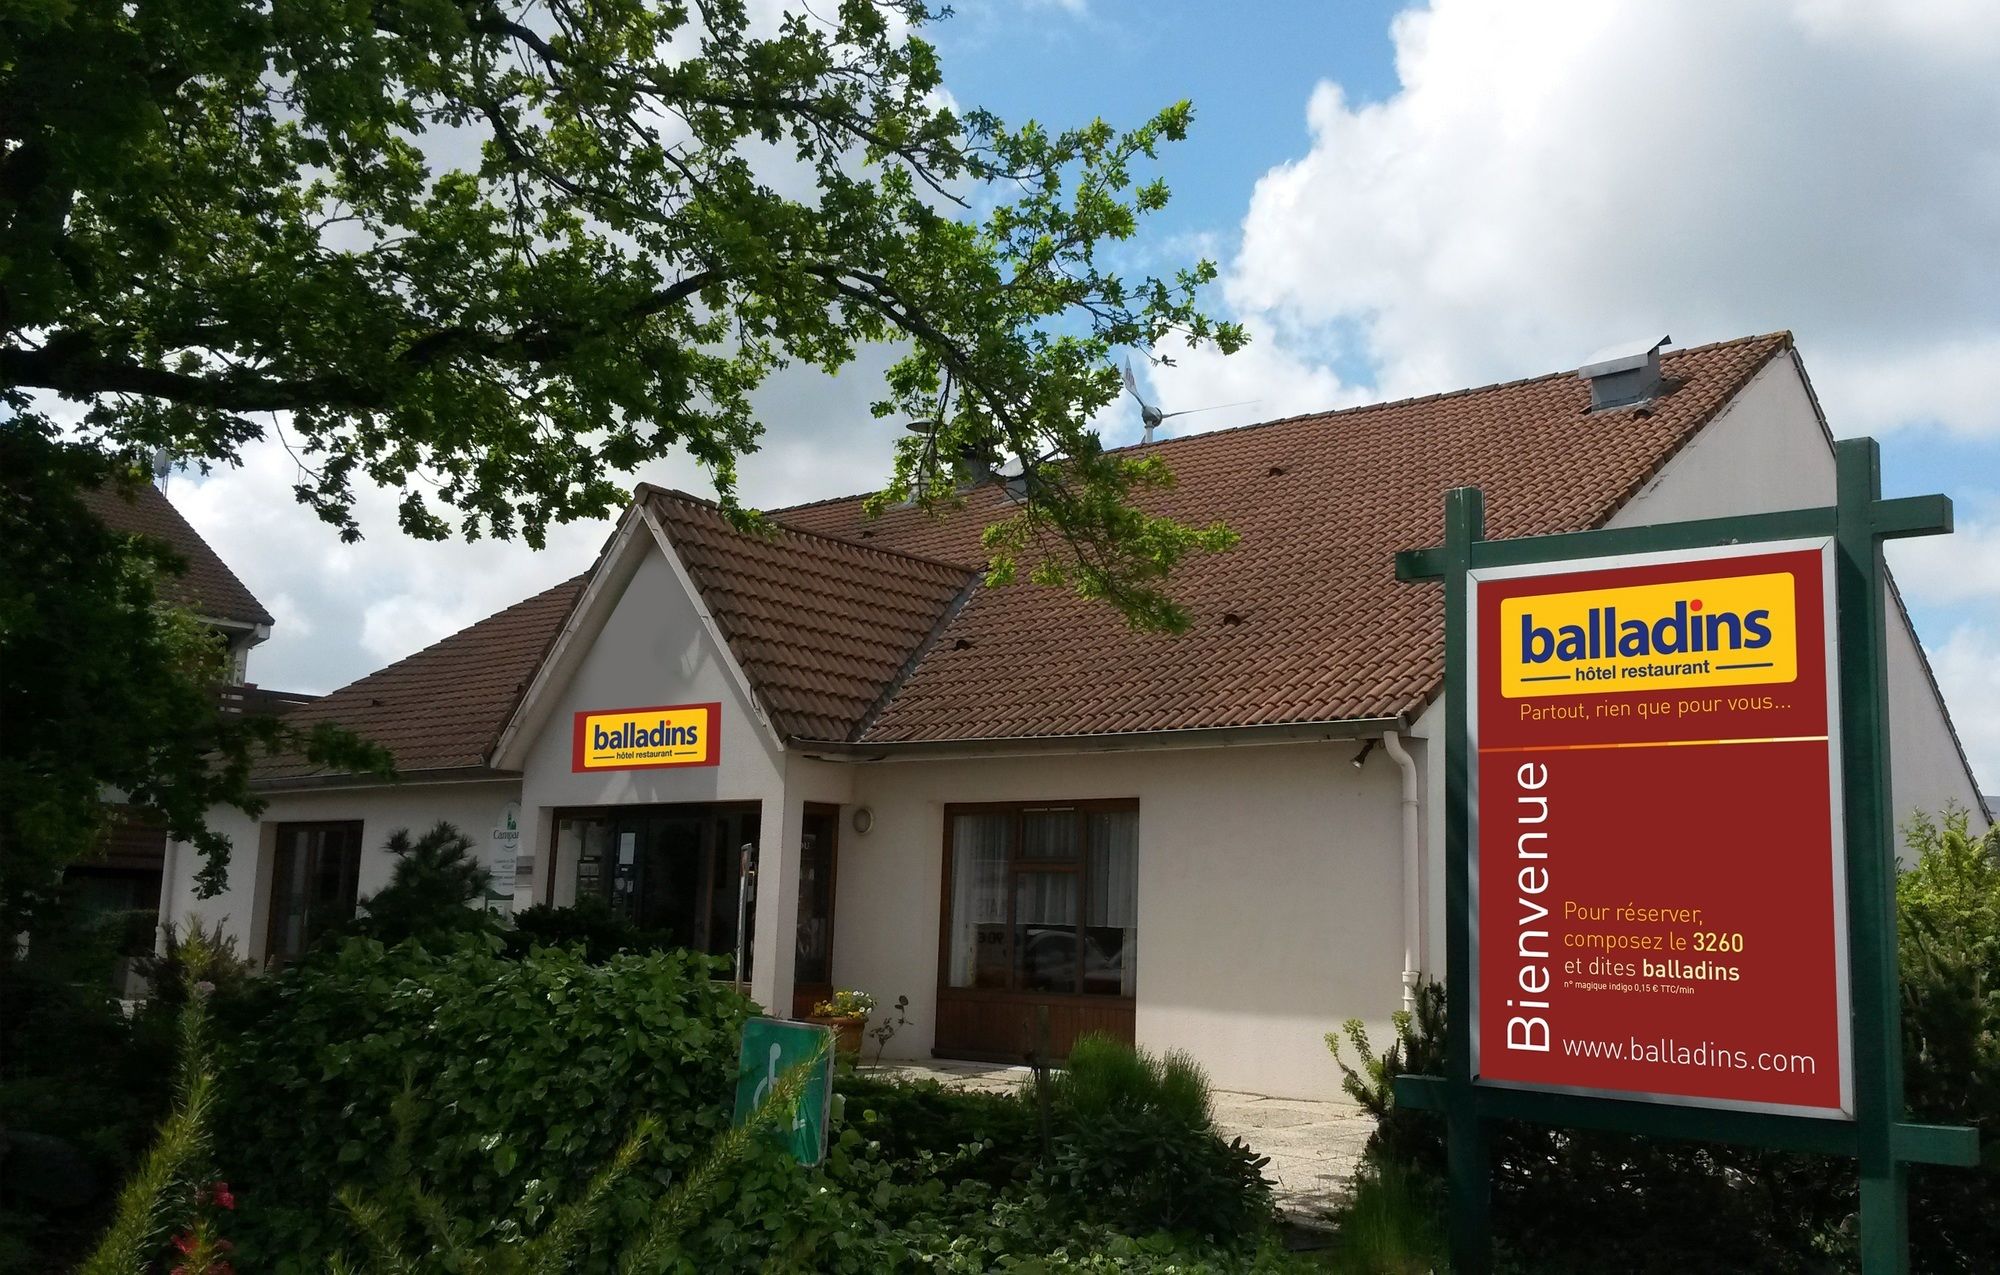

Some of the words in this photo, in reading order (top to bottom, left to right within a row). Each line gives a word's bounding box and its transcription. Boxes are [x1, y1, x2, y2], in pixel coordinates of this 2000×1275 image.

[1521, 599, 1772, 664] balladins
[1575, 665, 1616, 682] hôtel
[1621, 660, 1710, 679] restaurant
[1520, 703, 1590, 721] Partout,
[1596, 700, 1631, 717] rien
[1637, 701, 1671, 720] que
[1678, 699, 1723, 717] pour
[1727, 696, 1791, 711] vous...
[594, 720, 698, 750] balladins
[616, 751, 634, 760] hôtel
[635, 749, 673, 759] restaurant
[1506, 762, 1550, 1053] Bienvenue
[1564, 901, 1610, 921] Pour
[1616, 902, 1703, 926] réserver,
[1564, 933, 1663, 953] composez
[1669, 931, 1687, 951] le
[1692, 932, 1744, 952] 3260
[1564, 958, 1582, 975] et
[1588, 956, 1636, 977] dites
[1642, 958, 1740, 982] balladins
[1574, 982, 1607, 992] magique
[1608, 982, 1633, 993] indigo
[1652, 984, 1659, 993] €
[1660, 984, 1695, 995] TTC/min
[1562, 1036, 1816, 1075] www.balladins.com
